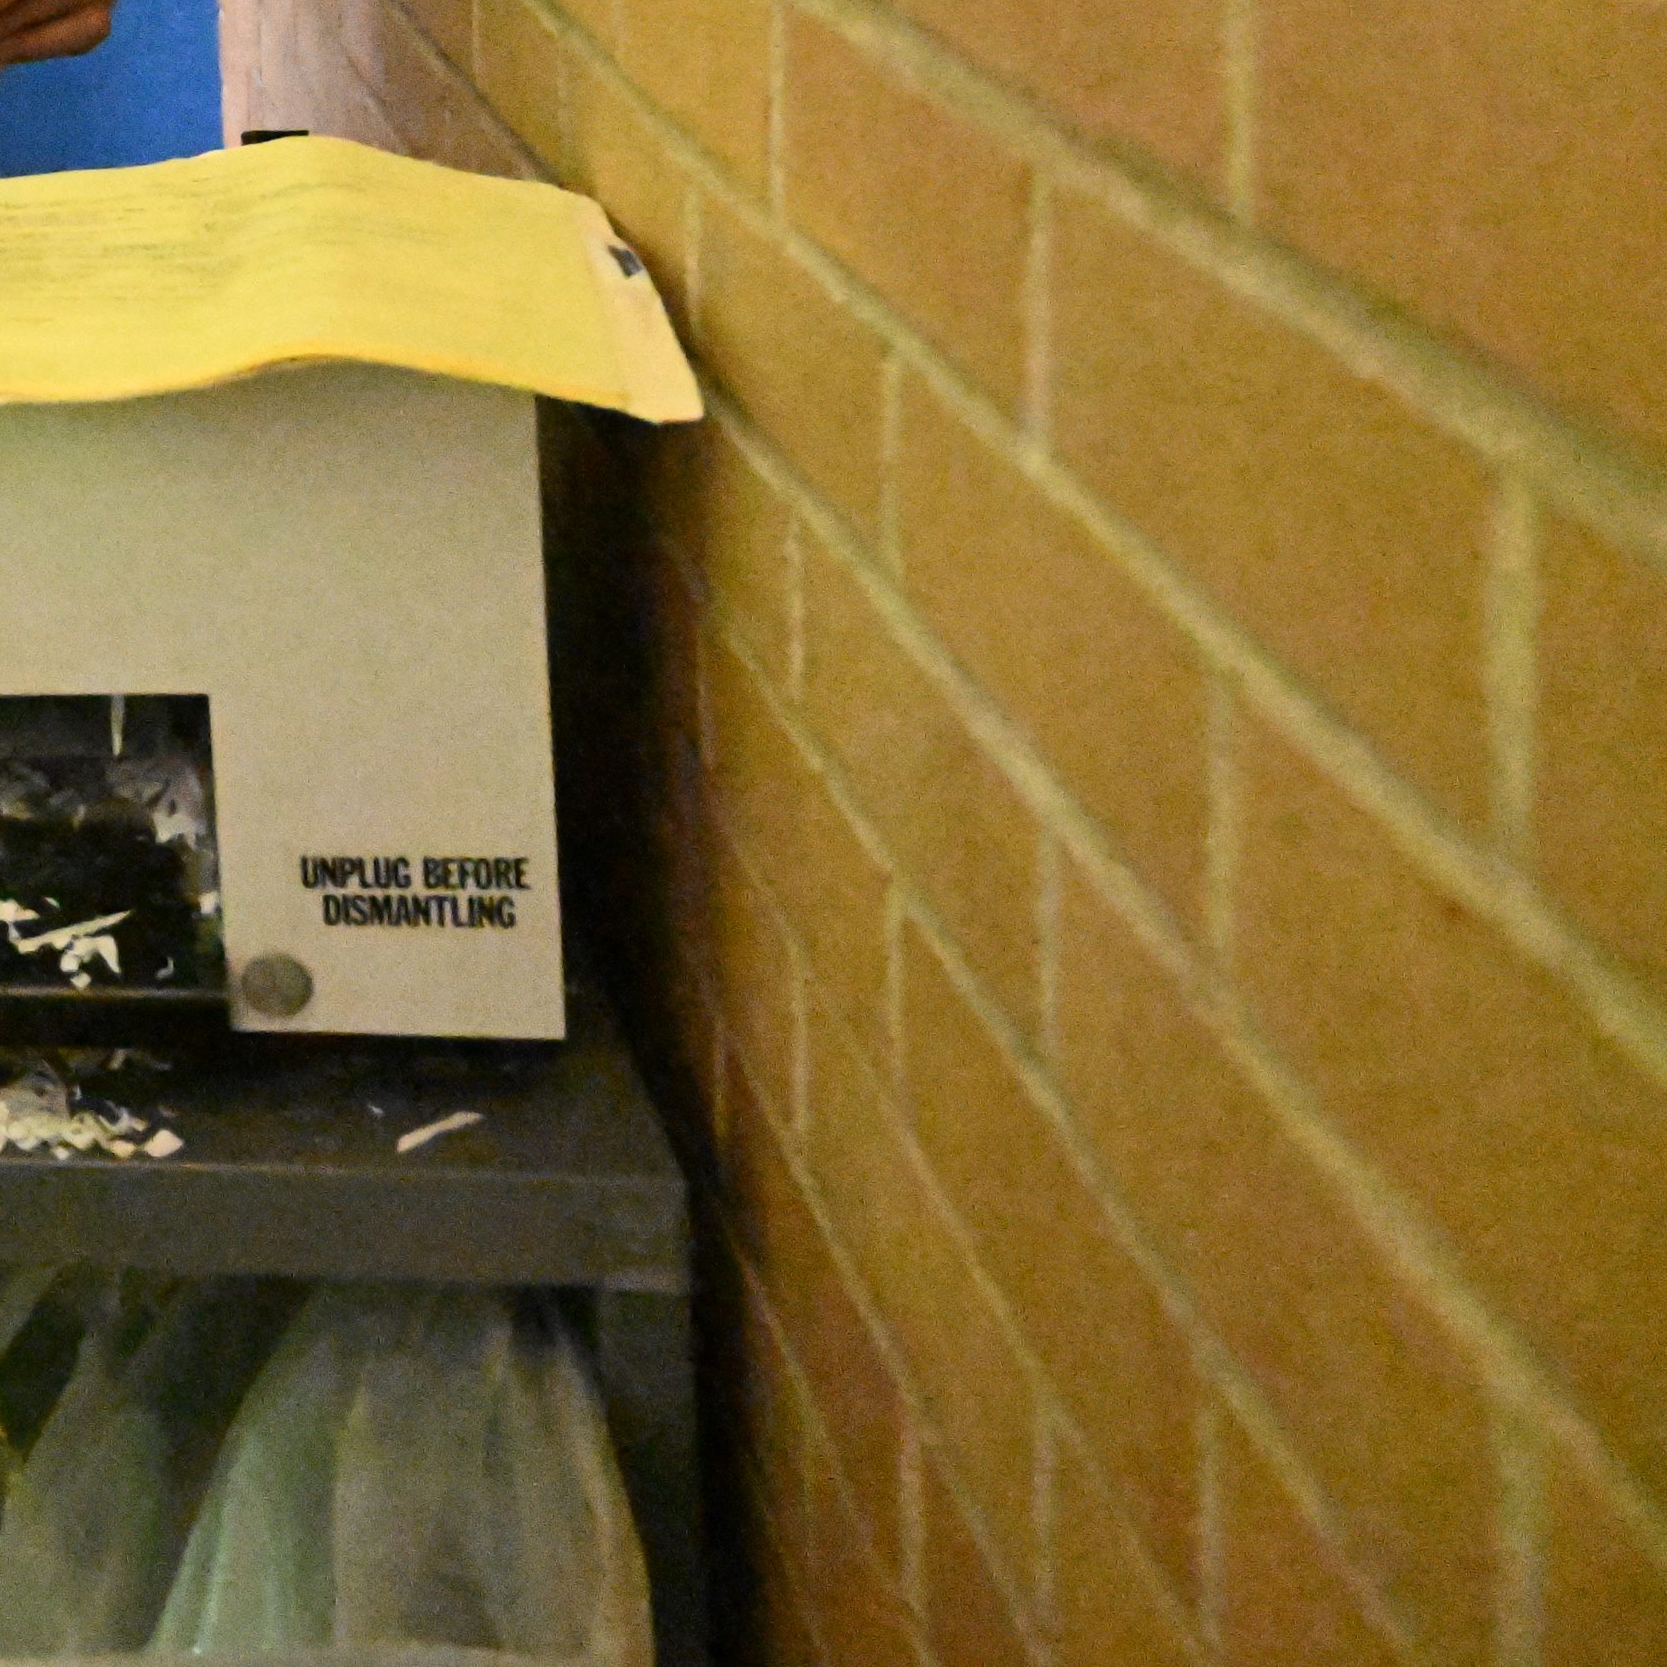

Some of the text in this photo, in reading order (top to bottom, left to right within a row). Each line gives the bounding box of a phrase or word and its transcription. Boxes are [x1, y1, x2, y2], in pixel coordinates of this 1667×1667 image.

[300, 855, 530, 890] UNPLUG BEFORE
[322, 894, 516, 928] DISMANTLING
